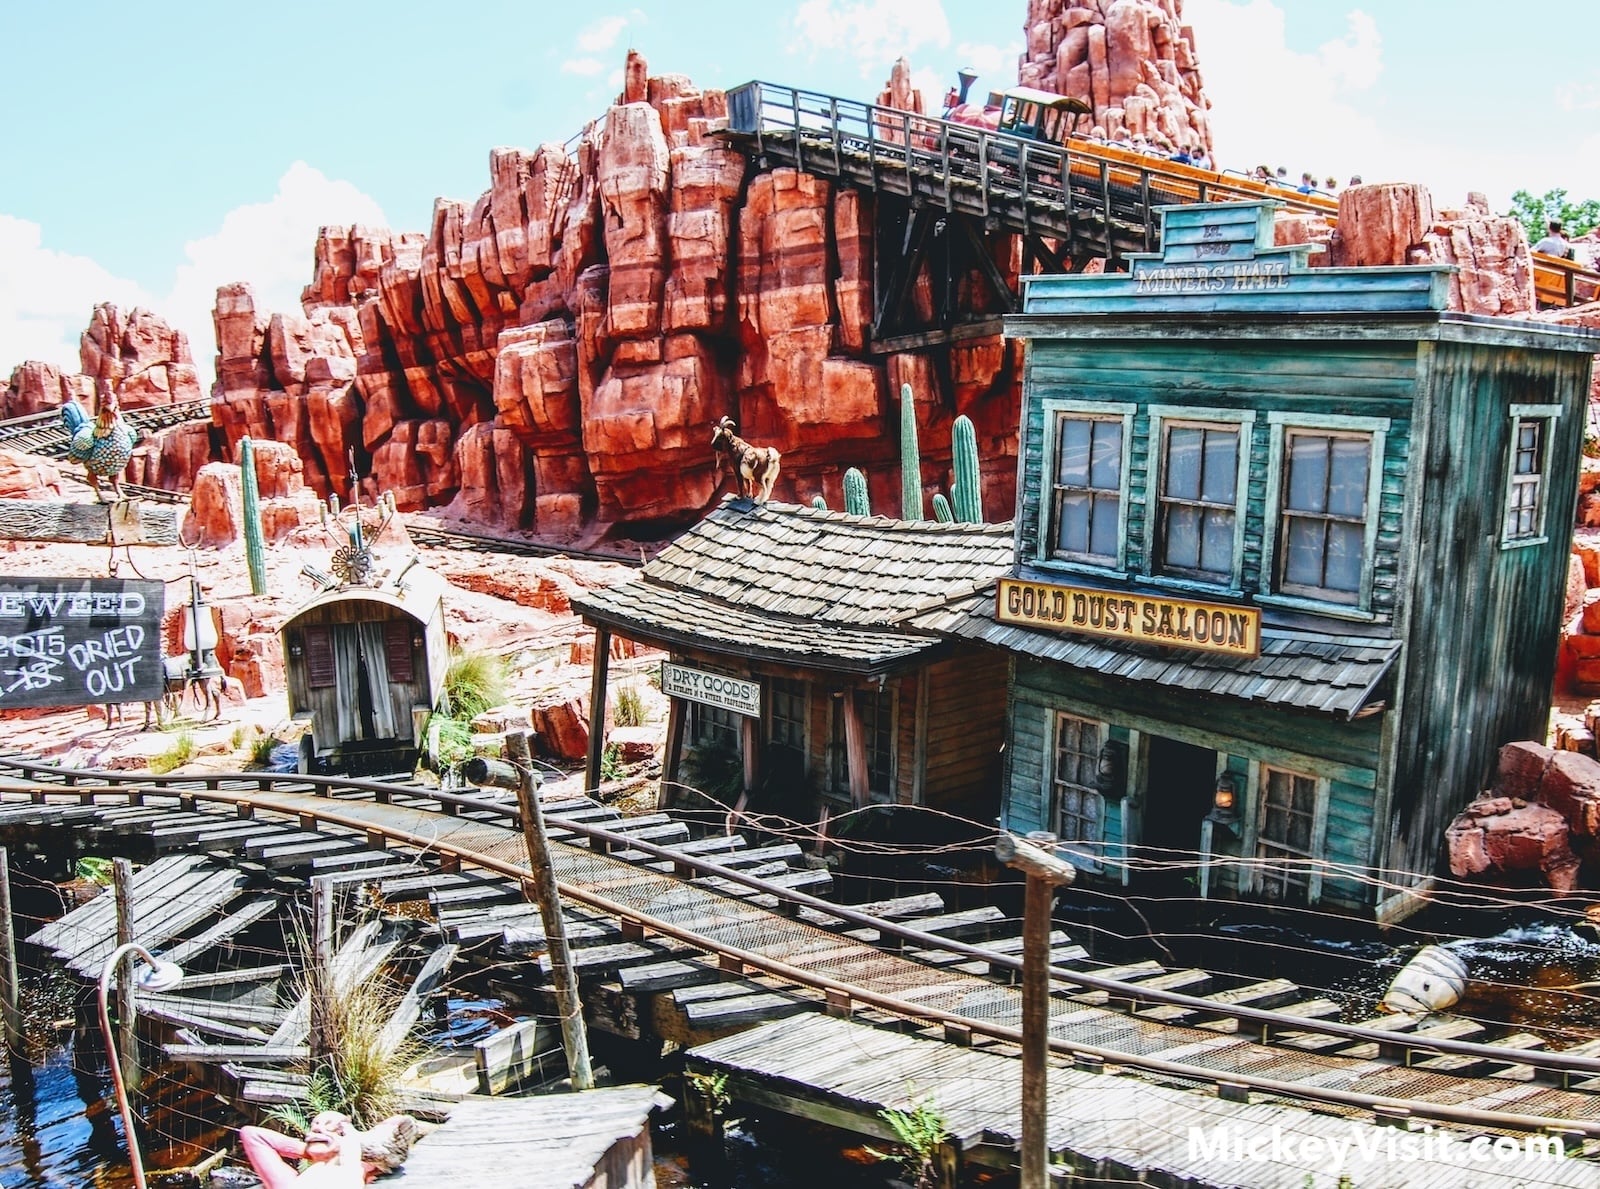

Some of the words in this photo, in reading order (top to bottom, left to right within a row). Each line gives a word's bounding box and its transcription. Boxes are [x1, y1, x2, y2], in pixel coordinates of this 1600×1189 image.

[1136, 265, 1226, 294] MINERS
[1232, 262, 1289, 291] HALL
[1007, 585, 1068, 623] GOLD
[1072, 592, 1137, 633] DUST
[1142, 602, 1250, 649] SALOON
[67, 625, 145, 671] DRIED
[86, 655, 142, 697] OUT
[672, 668, 703, 688] DRY
[703, 675, 751, 700] GOODS
